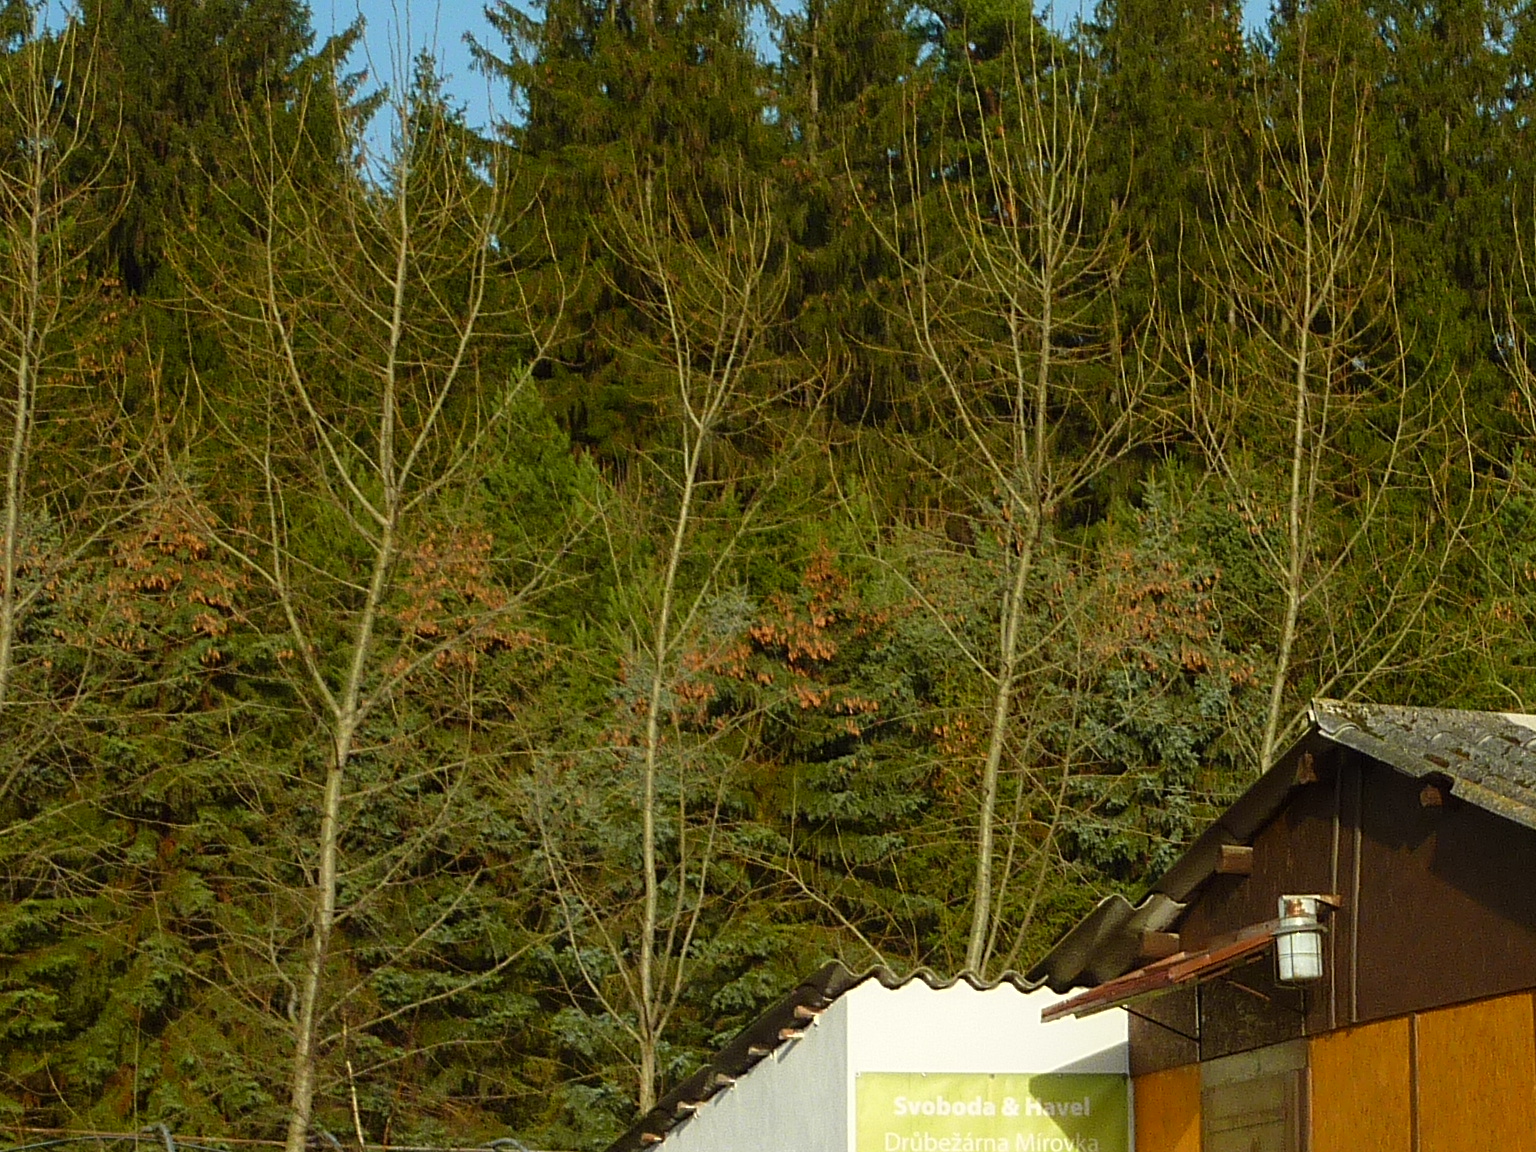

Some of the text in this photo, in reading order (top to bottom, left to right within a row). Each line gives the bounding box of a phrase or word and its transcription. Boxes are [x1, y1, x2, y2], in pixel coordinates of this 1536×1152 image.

[894, 1096, 1090, 1116] Svoboda & Havel
[885, 1132, 1099, 1152] Drůbežárna Mírovka
